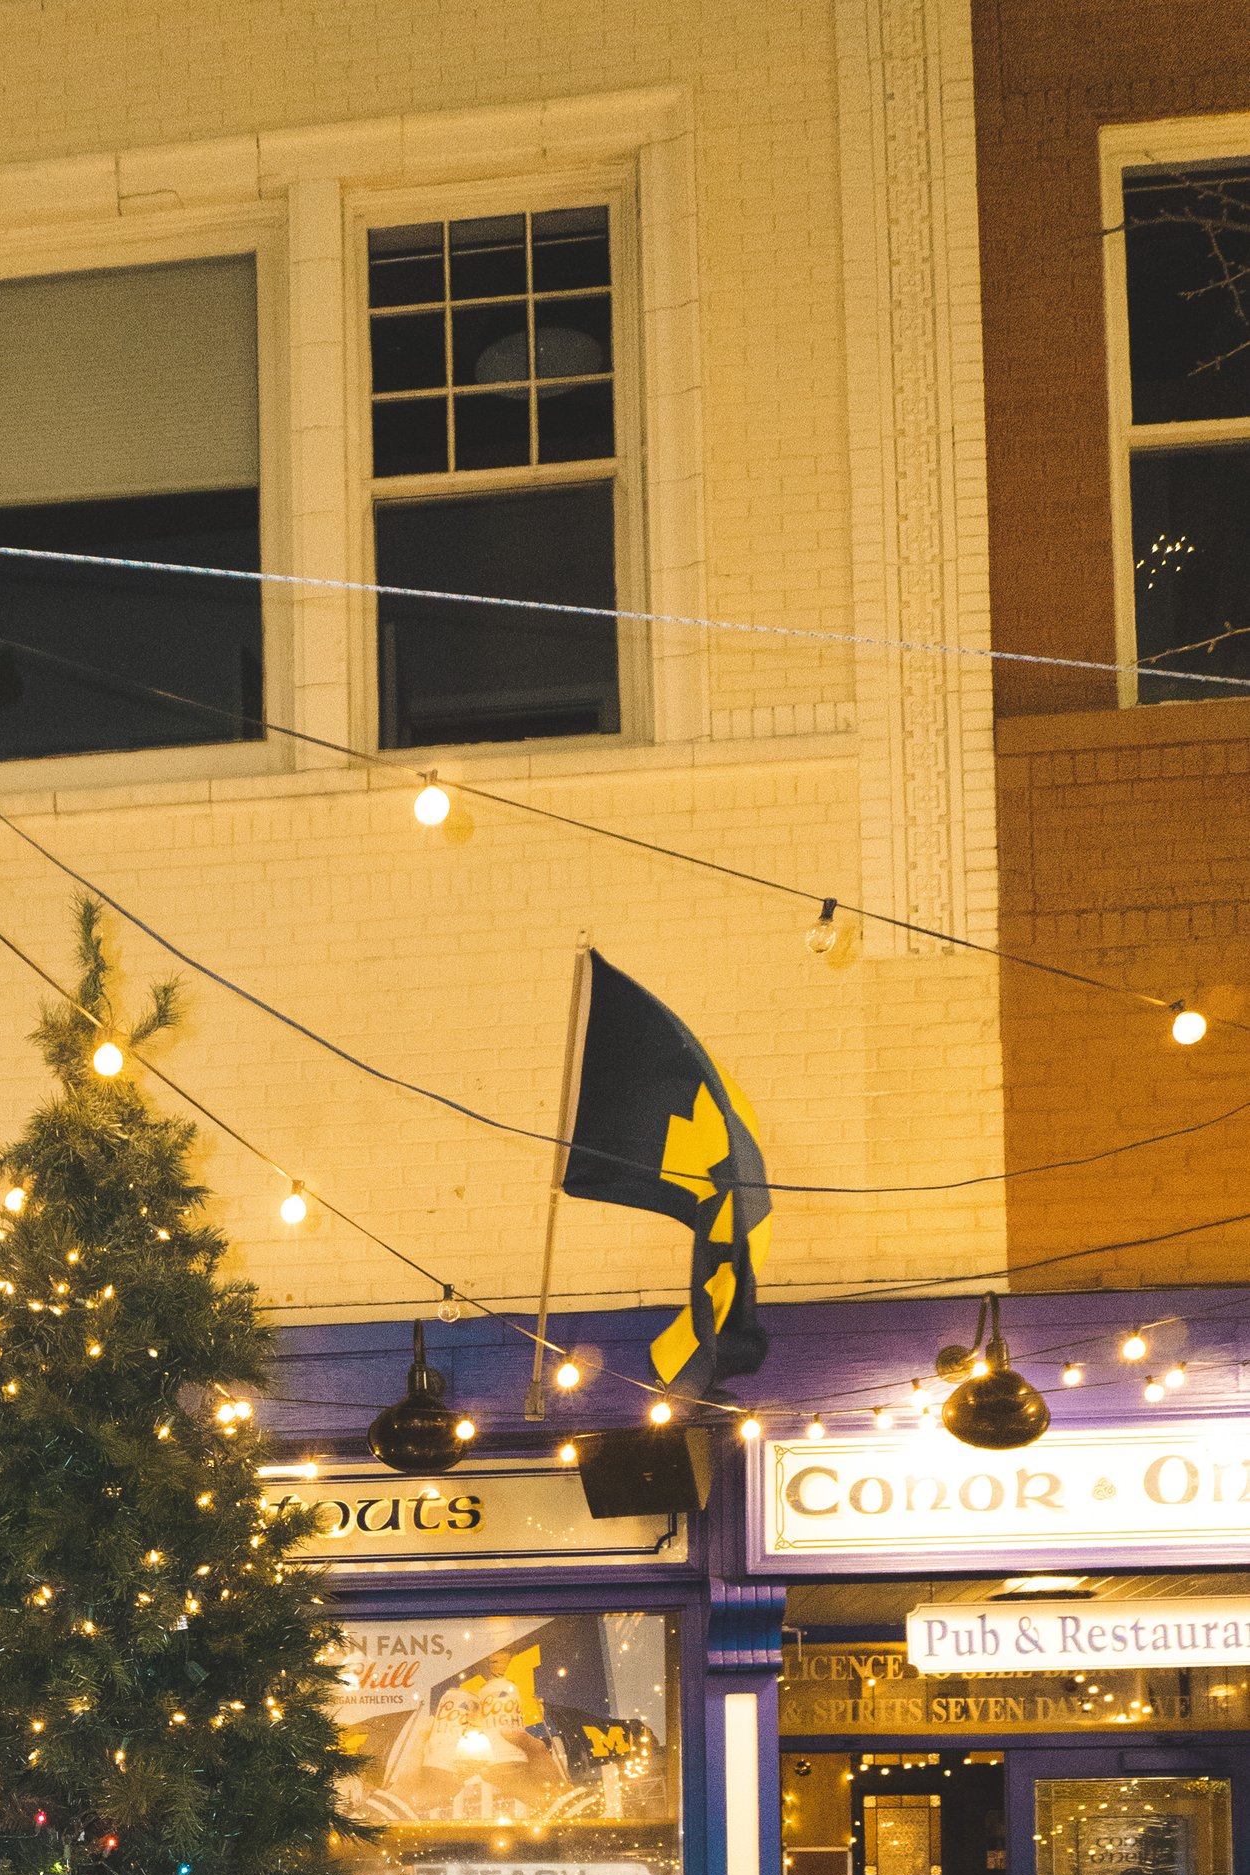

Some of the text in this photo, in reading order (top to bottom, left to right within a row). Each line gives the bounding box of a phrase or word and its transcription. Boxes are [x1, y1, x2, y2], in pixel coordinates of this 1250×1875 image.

[377, 1633, 453, 1660] FANS,
[923, 1614, 1001, 1657] Pub
[1015, 1616, 1046, 1655] &
[783, 1655, 904, 1681] LICENCE
[358, 1694, 404, 1706] ATHLETICS
[814, 1699, 923, 1724] SPIRITS
[931, 1697, 1026, 1723] SEVEN
[582, 1725, 630, 1757] M
